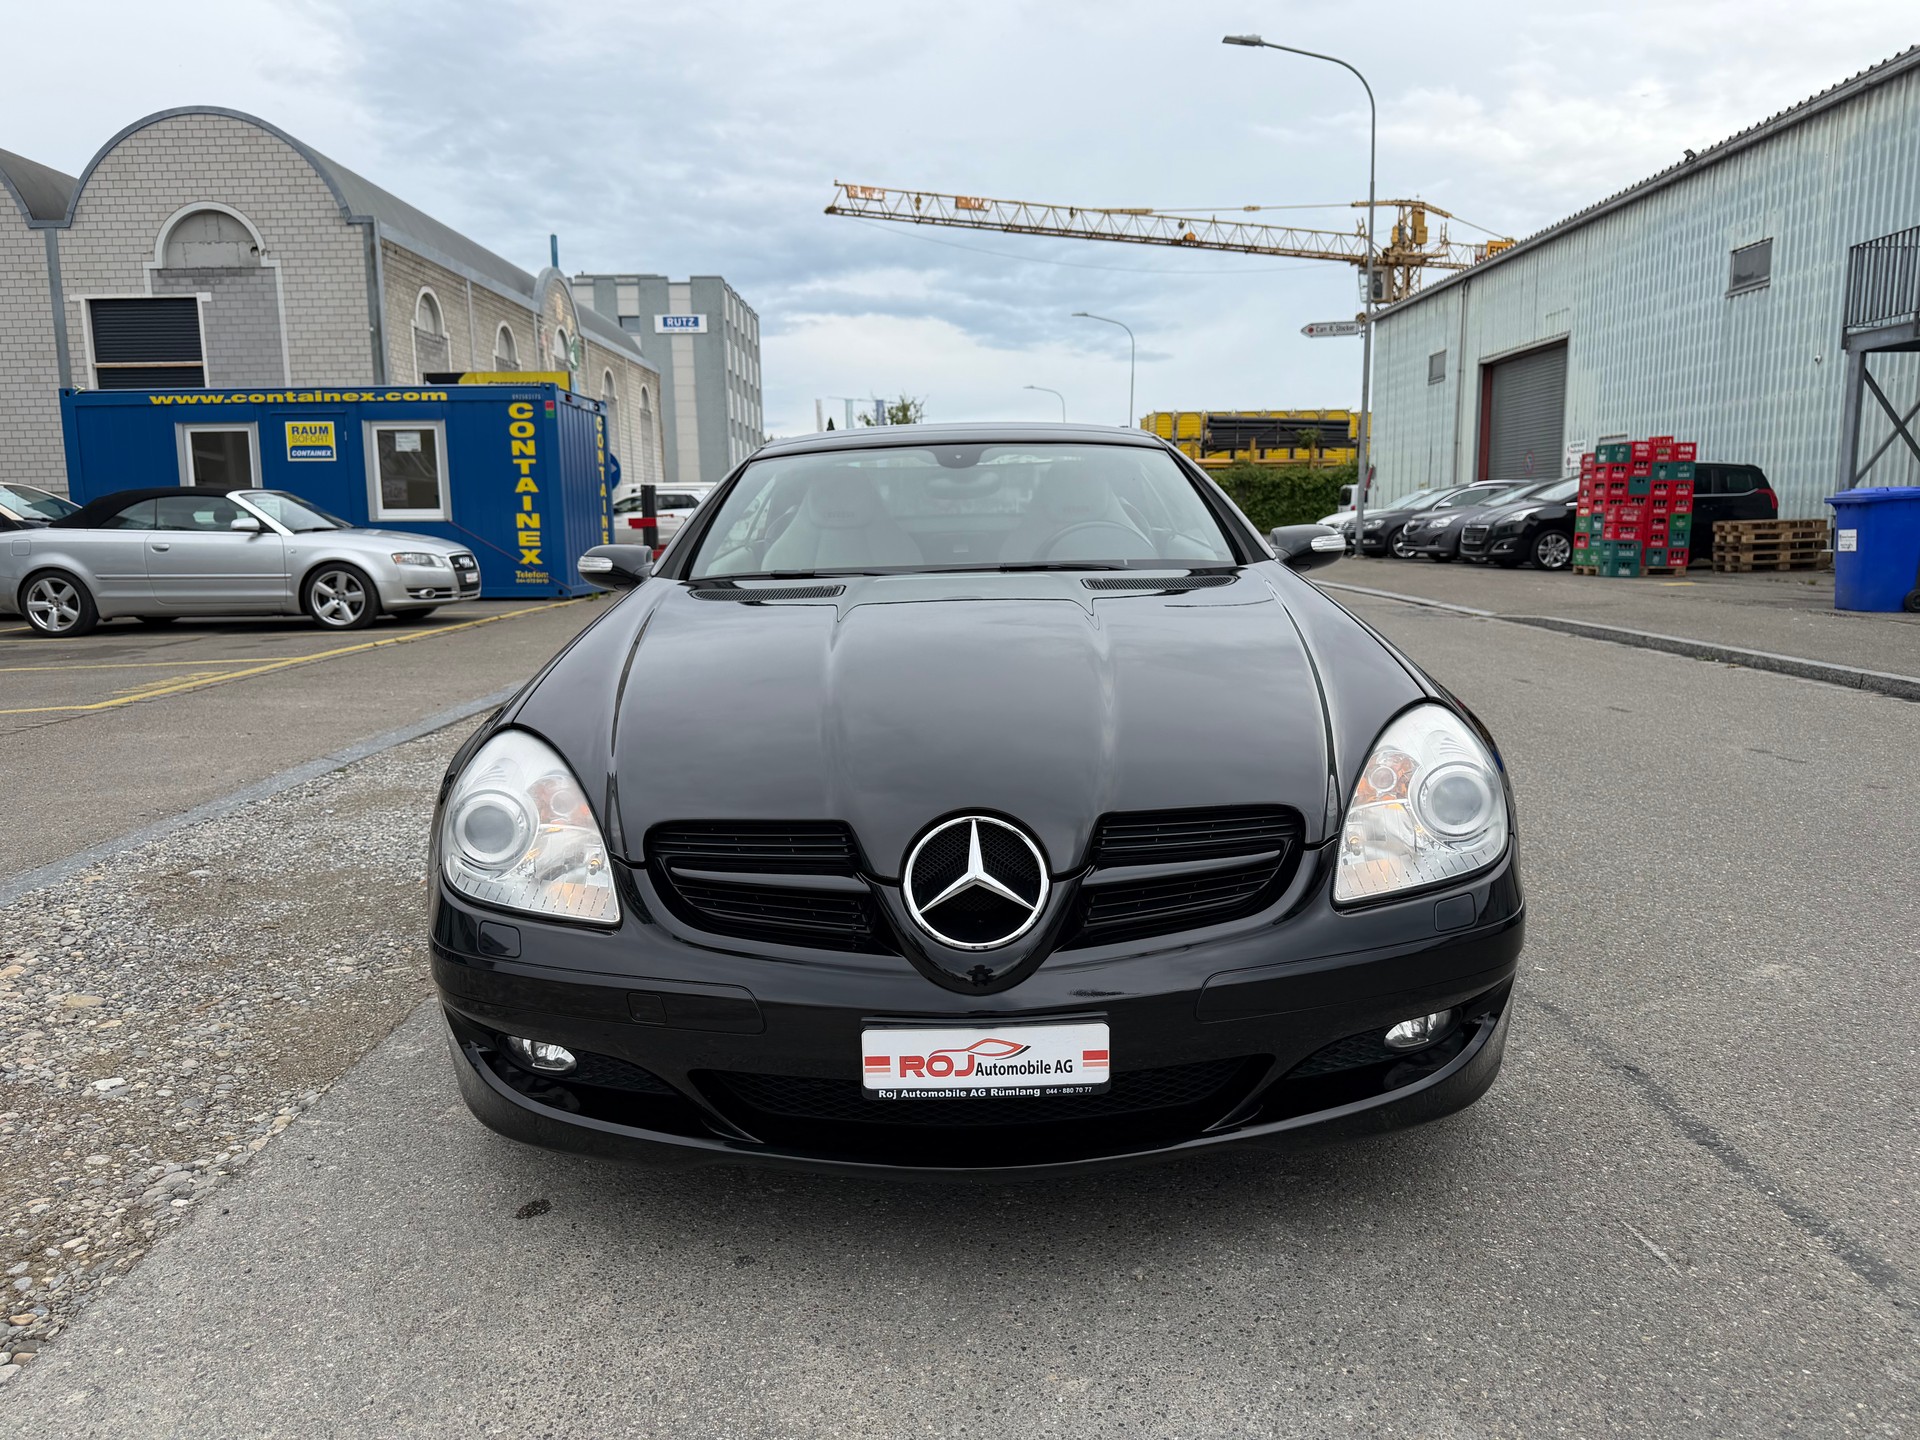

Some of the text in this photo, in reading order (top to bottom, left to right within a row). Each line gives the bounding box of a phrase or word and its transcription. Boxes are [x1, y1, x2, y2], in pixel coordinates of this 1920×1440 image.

[666, 316, 696, 327] RUTZ
[149, 390, 448, 405] www.containex.com
[291, 426, 329, 435] RAUM
[291, 434, 328, 443] SOFORT
[291, 449, 332, 457] CONTAINEX
[508, 402, 543, 564] CONTAINEX
[596, 415, 609, 544] CONTAINE
[899, 1054, 1073, 1078] ROJ Automobile AG
[878, 1090, 897, 1100] Roj
[901, 1089, 967, 1098] Automobile
[970, 1088, 986, 1097] AG
[990, 1087, 1041, 1097] Rümlang
